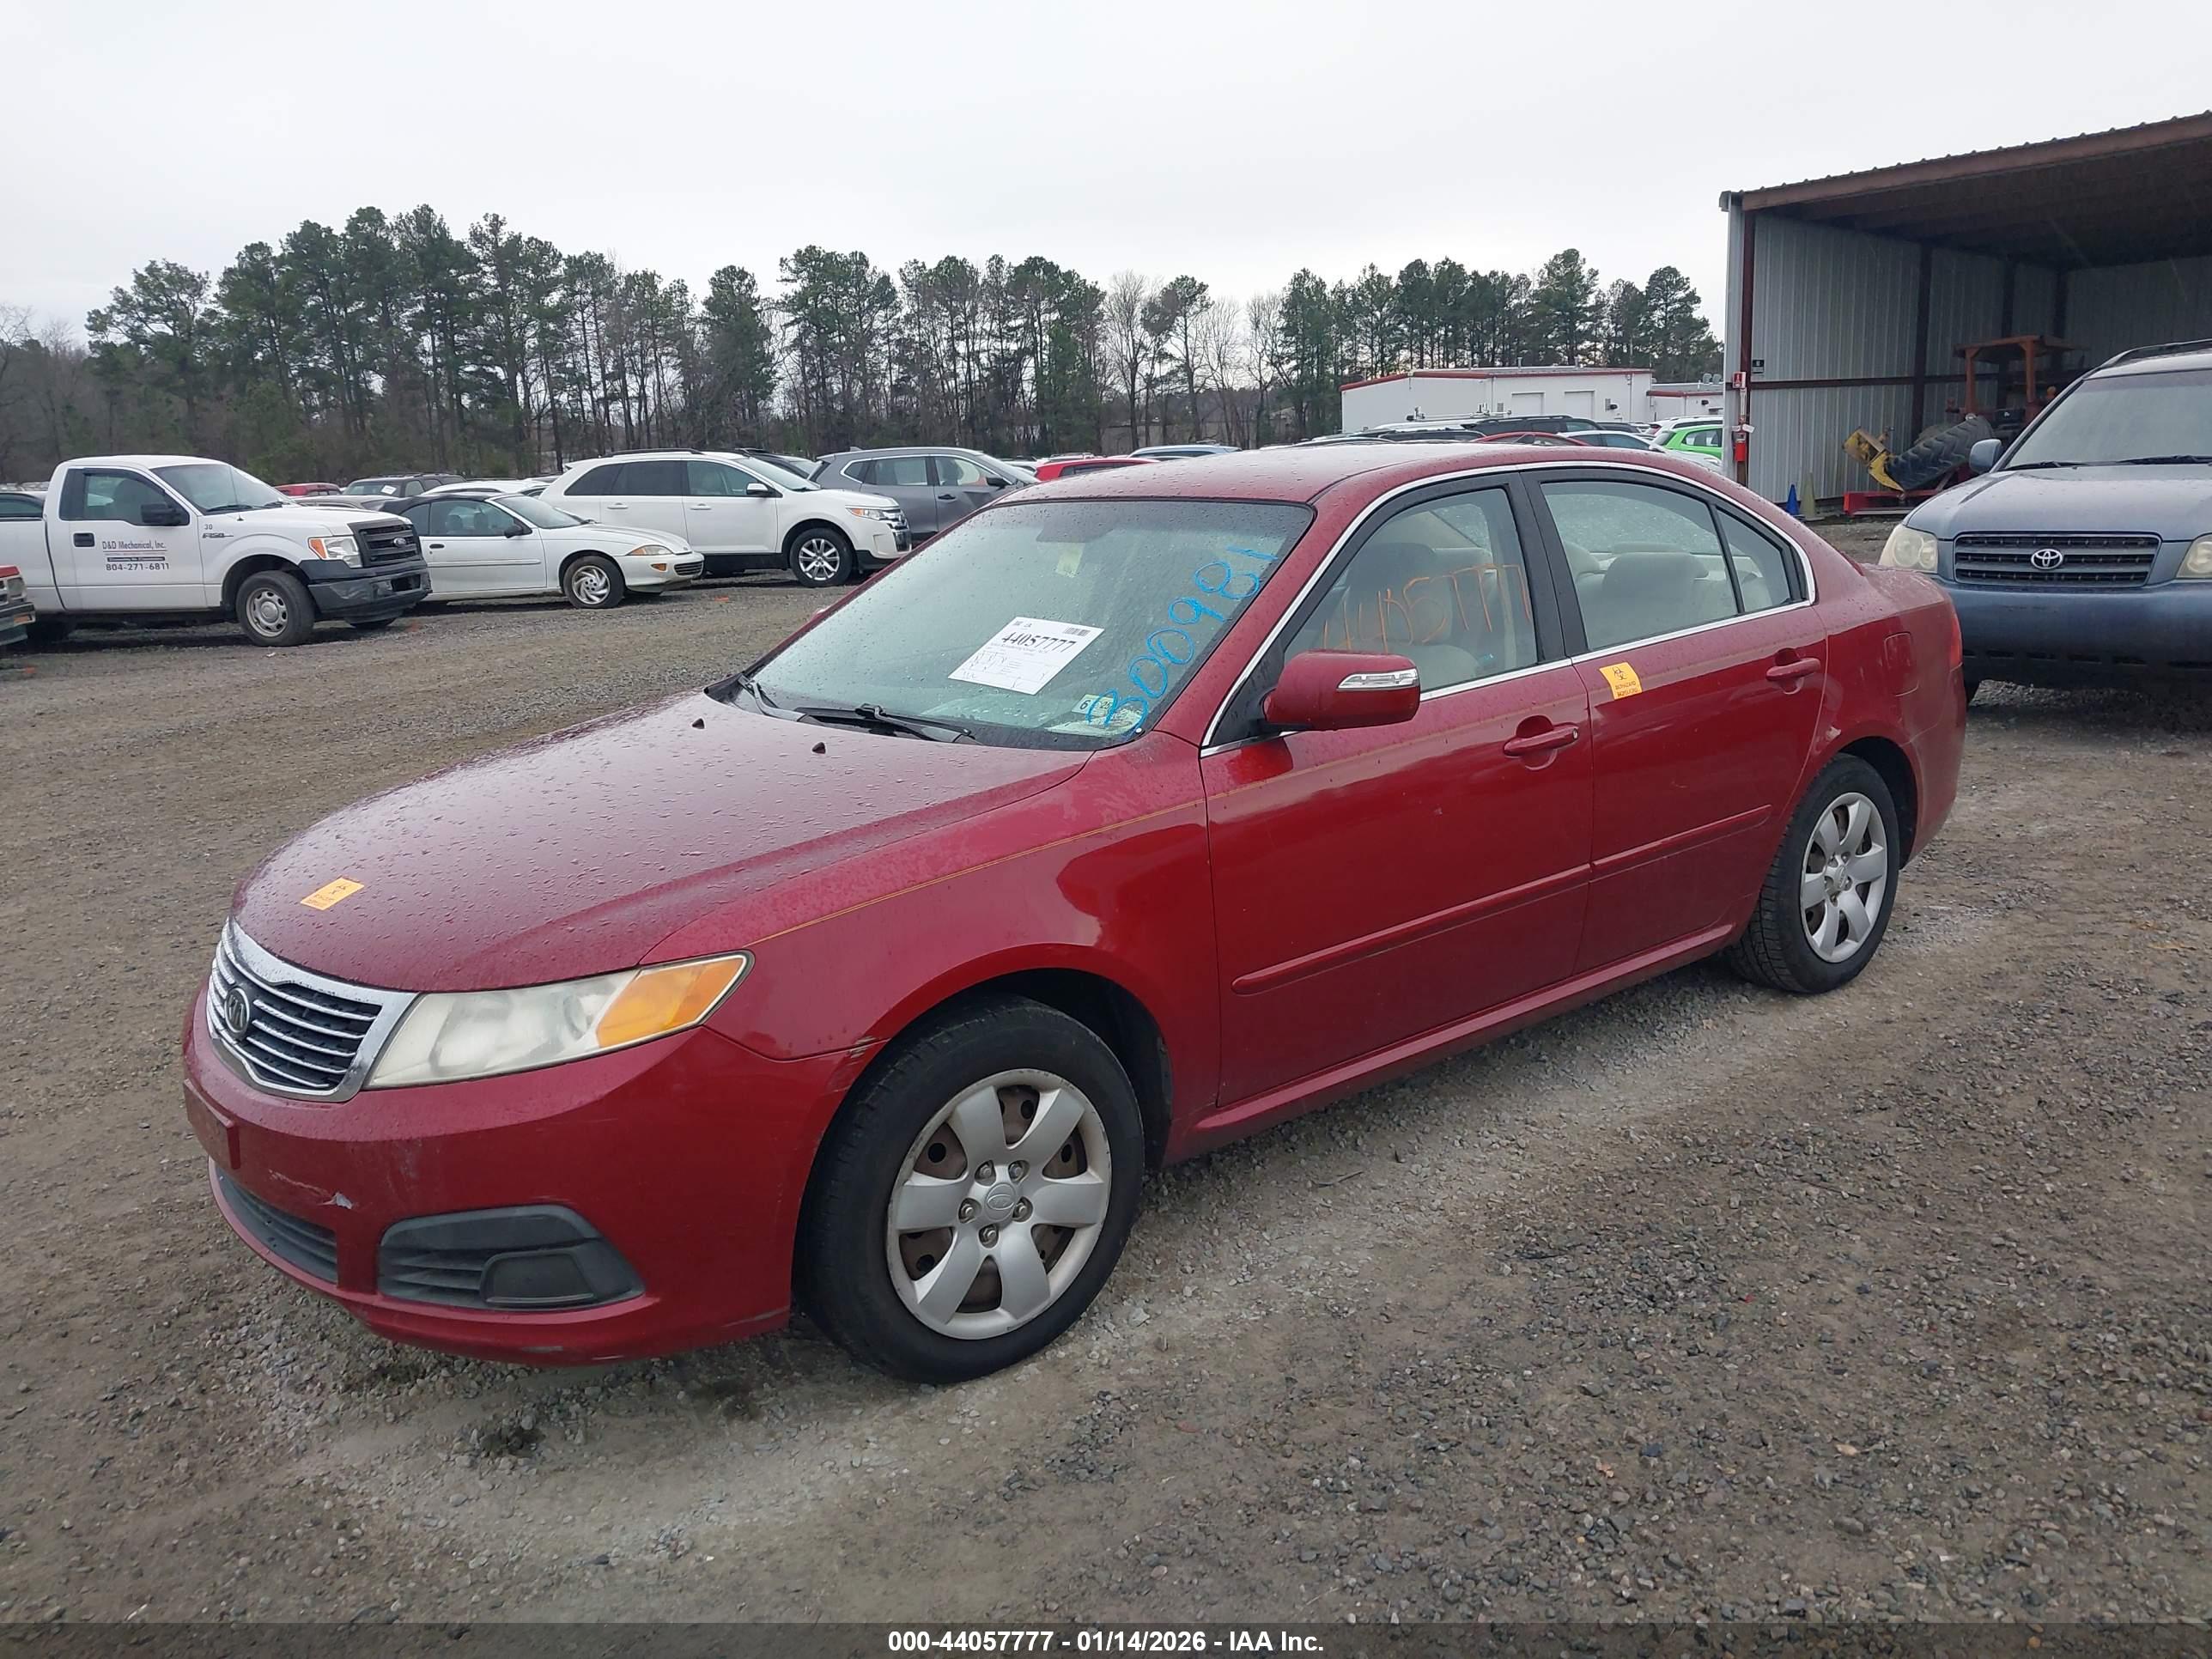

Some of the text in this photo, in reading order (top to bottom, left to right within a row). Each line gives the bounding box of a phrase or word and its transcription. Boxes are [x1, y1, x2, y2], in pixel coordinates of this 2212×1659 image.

[102, 539, 167, 550] D&D Mechanical, Inc.
[106, 562, 169, 571] 804-271-6811
[1001, 631, 1078, 653] 44057777
[1079, 699, 1091, 710] 6
